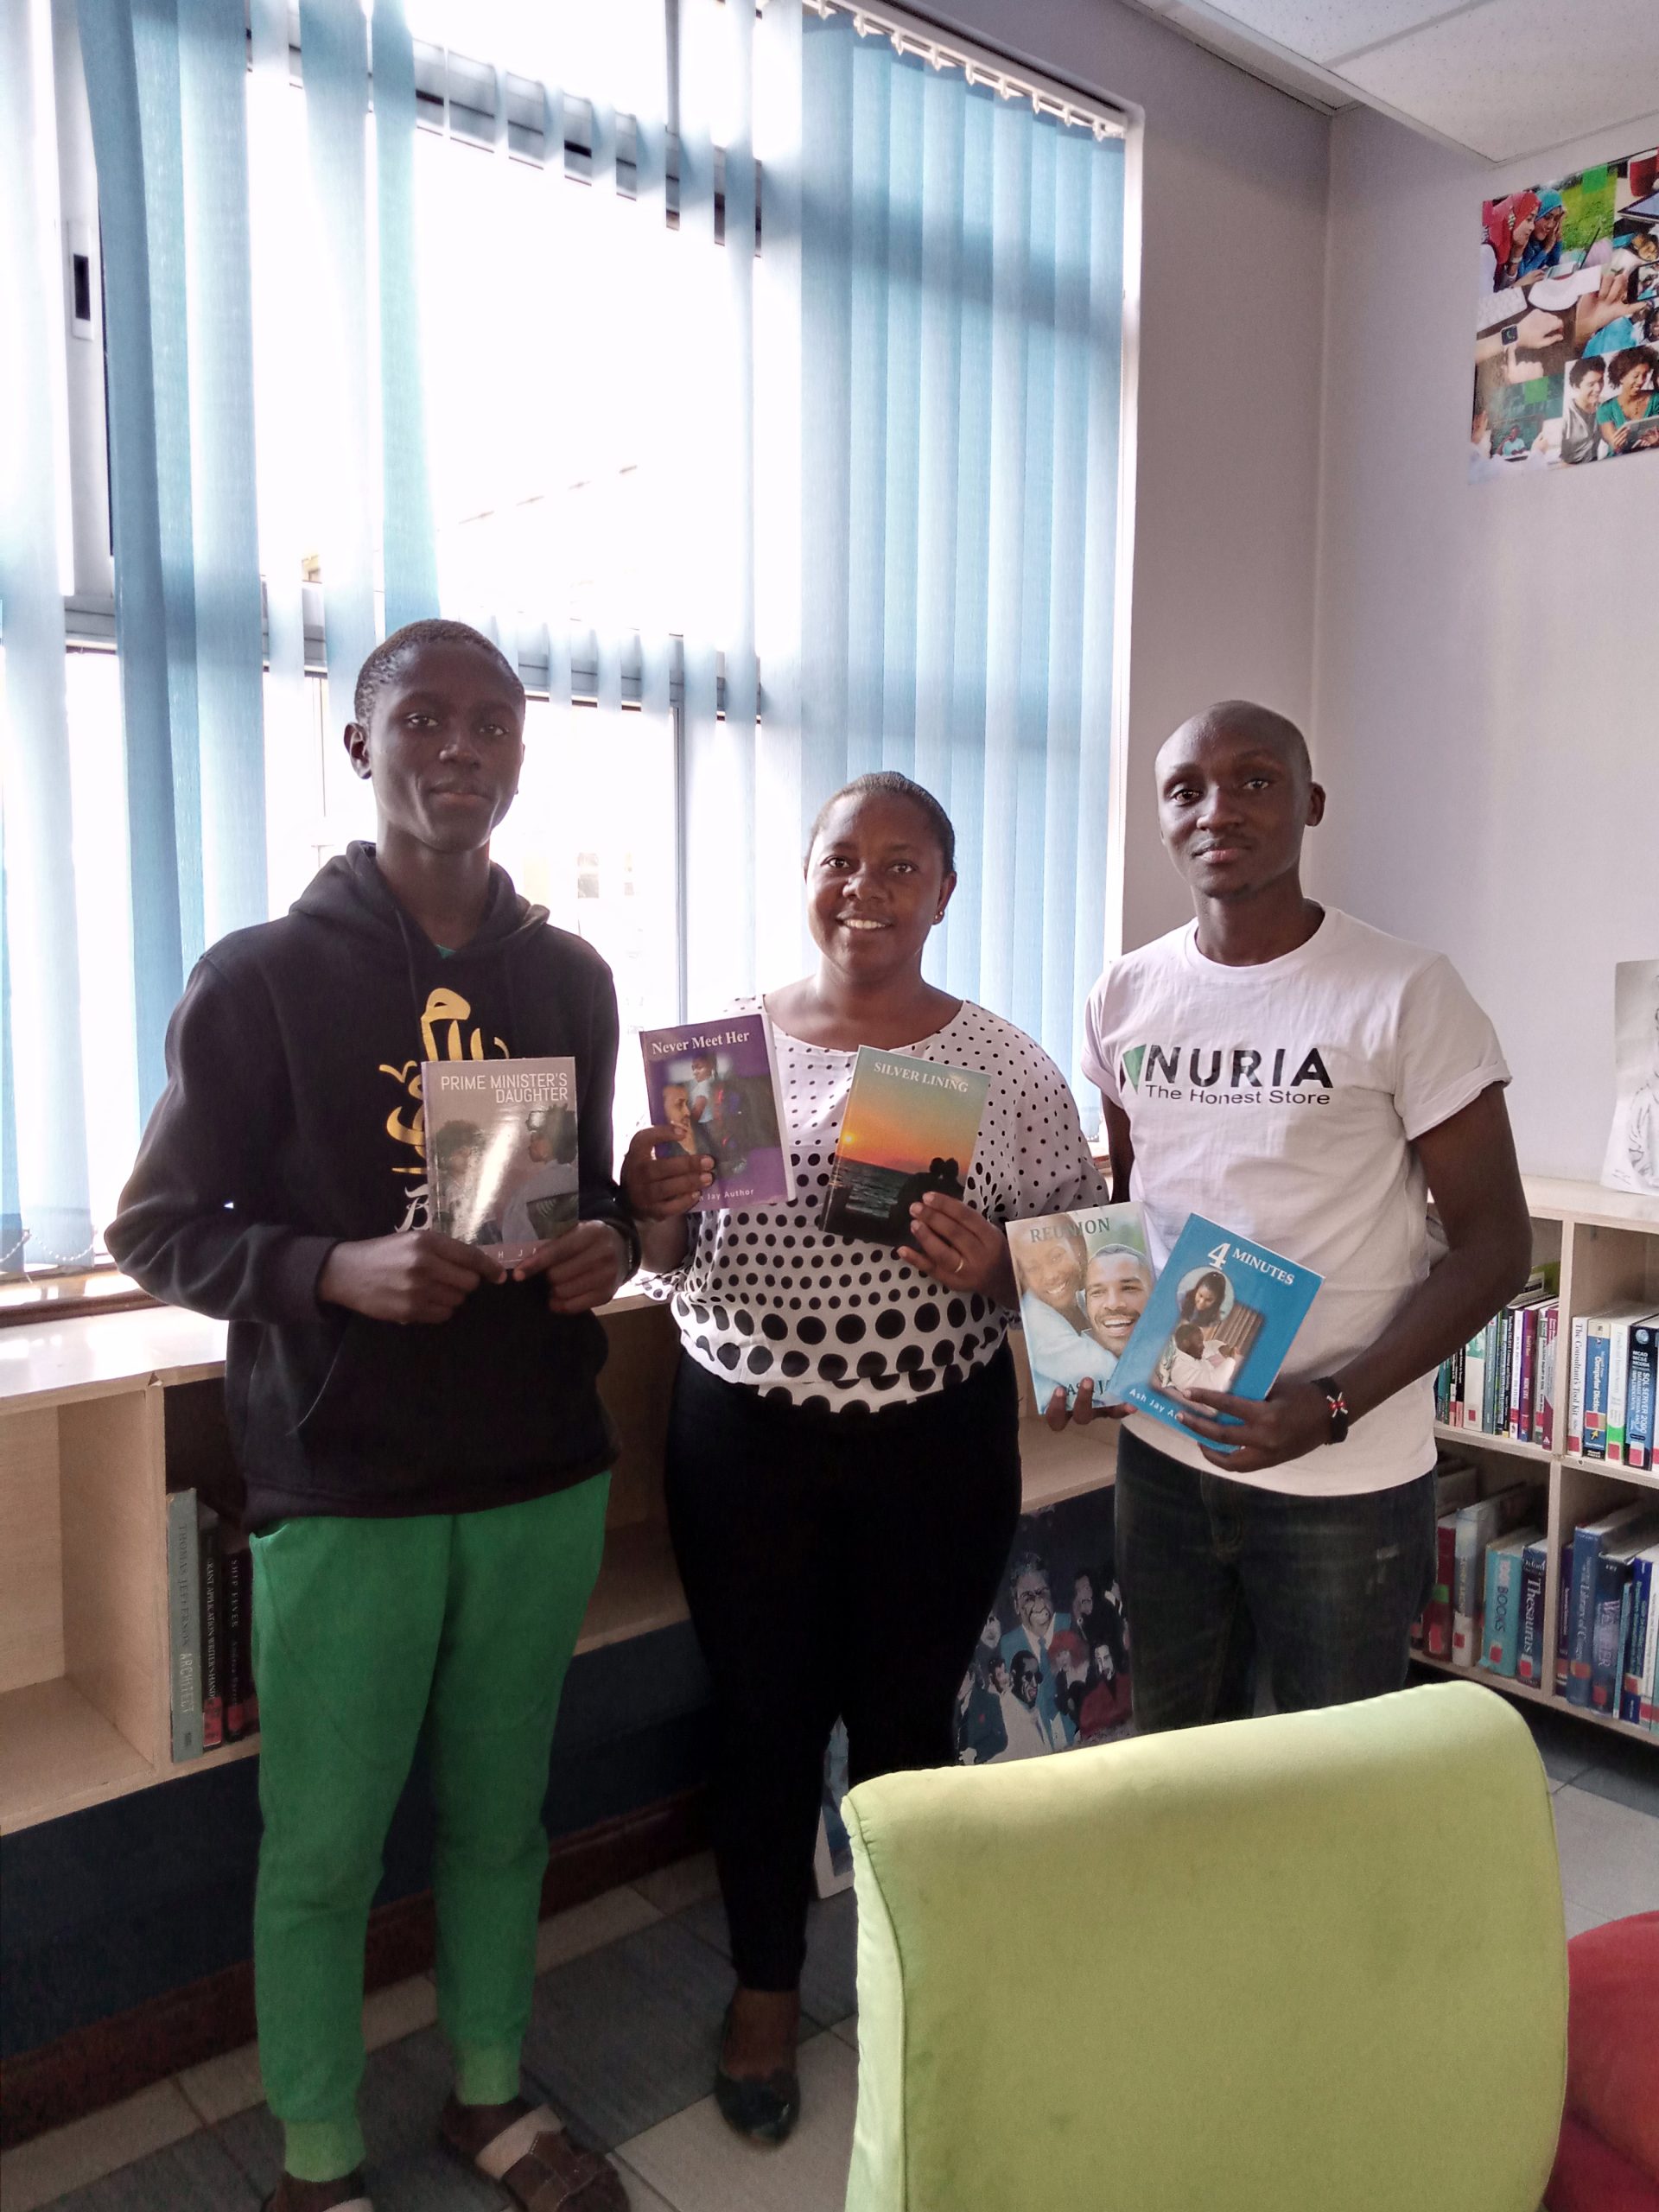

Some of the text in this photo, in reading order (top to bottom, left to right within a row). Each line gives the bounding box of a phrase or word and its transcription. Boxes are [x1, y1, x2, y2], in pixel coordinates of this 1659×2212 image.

[652, 1031, 750, 1055] Never Meet Her
[441, 1072, 568, 1090] PRIME MINISTER'S
[874, 1061, 969, 1093] SILVER LINING
[1145, 1045, 1334, 1089] NURIA
[495, 1087, 569, 1104] DAUGHTER
[1146, 1084, 1332, 1105] The Honest Store
[724, 1189, 754, 1198] Author
[1029, 1217, 1111, 1243] REUNION
[1207, 1243, 1295, 1287] 4 MINUTES
[1575, 1324, 1584, 1338] The
[1573, 1341, 1583, 1384] Consultant's
[1592, 1356, 1602, 1413] Computer Dictio
[1642, 1372, 1650, 1386] SQL
[1128, 1388, 1166, 1414] Ash Jay
[1571, 1405, 1580, 1416] Kit
[1641, 1387, 1649, 1414] SERVER
[177, 1524, 189, 1646] THOMAS JEFFERSON
[230, 1560, 239, 1629] SHIP FEVER
[207, 1586, 215, 1637] APPLICATION
[1494, 1586, 1510, 1632] BOOKS
[1523, 1578, 1542, 1653] Thesaurus
[179, 1652, 194, 1713] ARCHITECT
